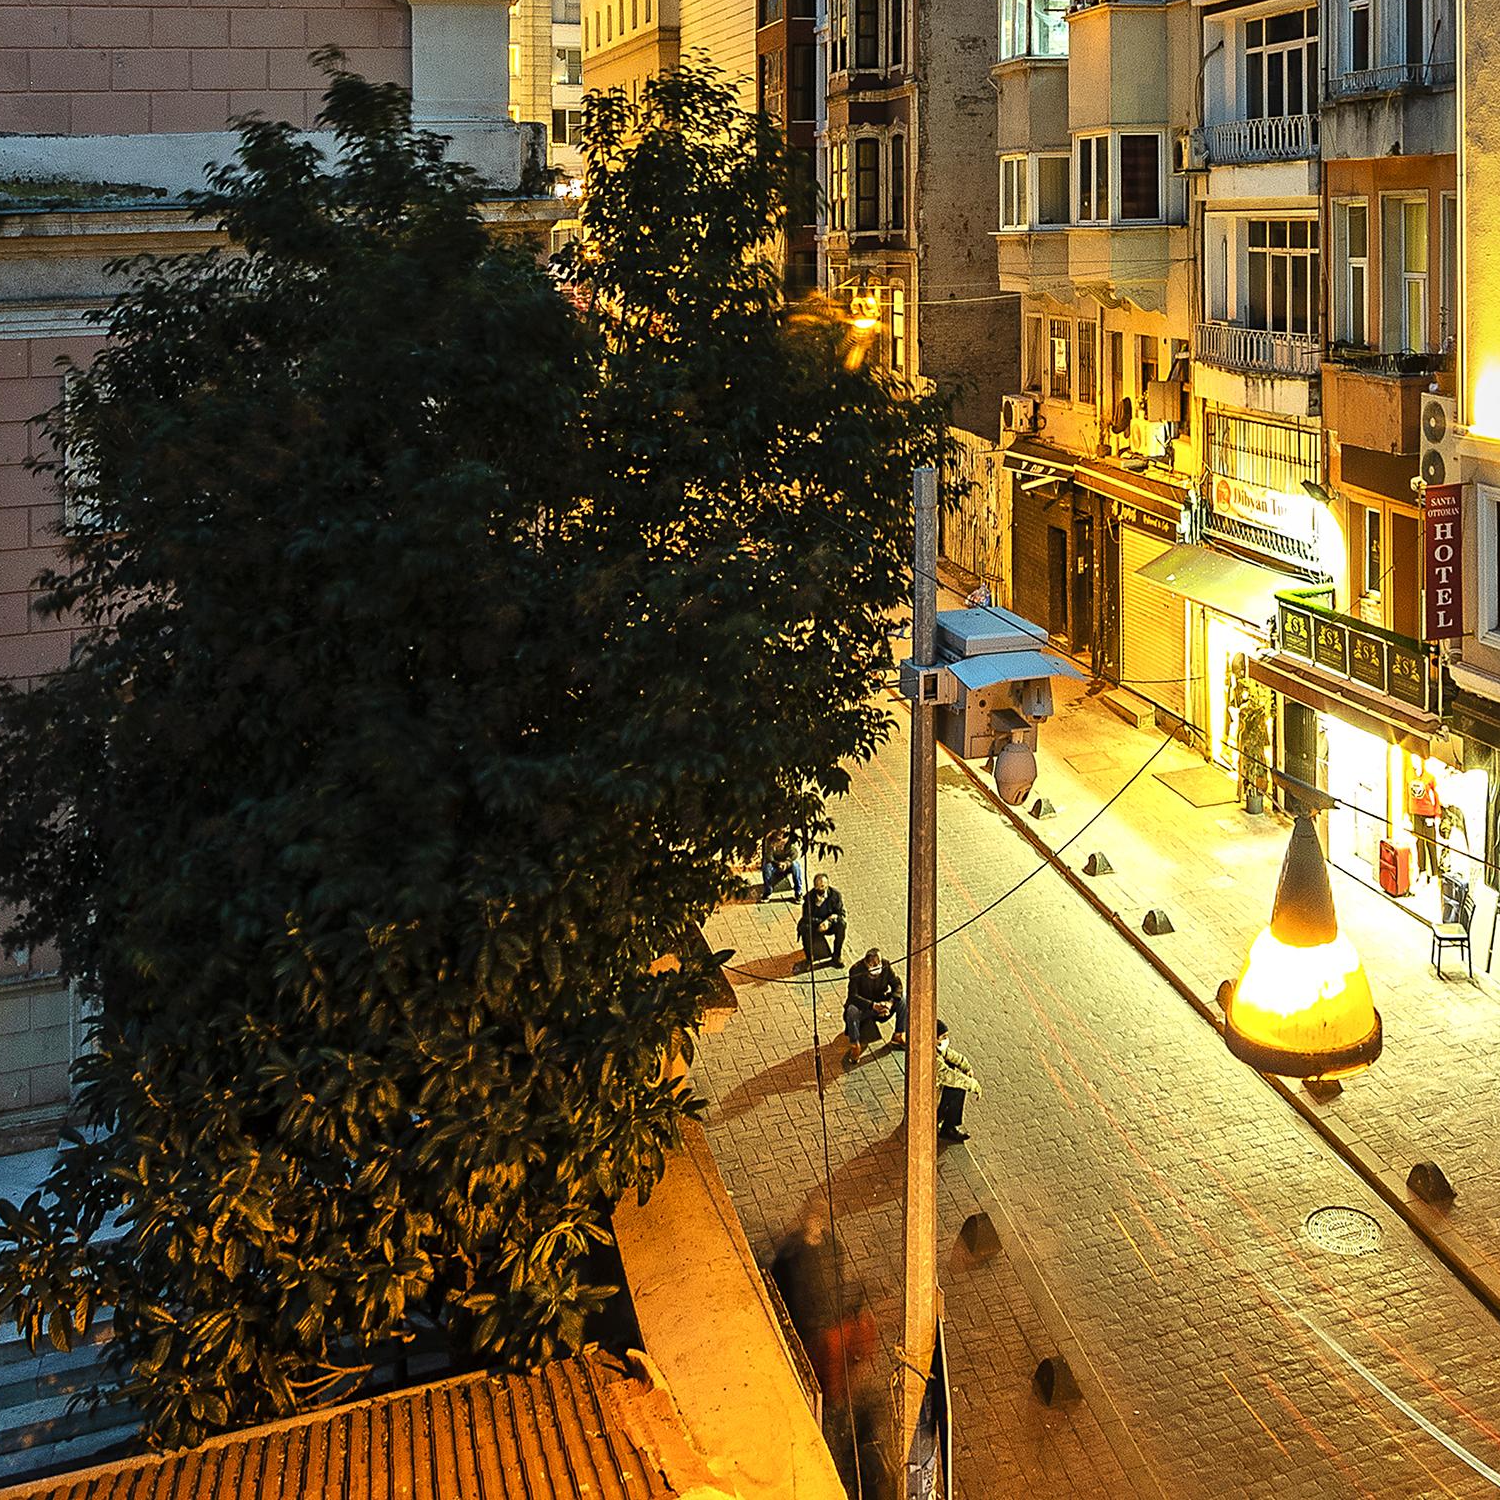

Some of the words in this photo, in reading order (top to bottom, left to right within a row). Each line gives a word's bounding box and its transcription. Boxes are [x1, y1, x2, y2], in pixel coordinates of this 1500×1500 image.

[1430, 496, 1456, 507] SANTA
[1427, 506, 1460, 518] OTTOMAN
[1434, 522, 1453, 628] HOTEL
